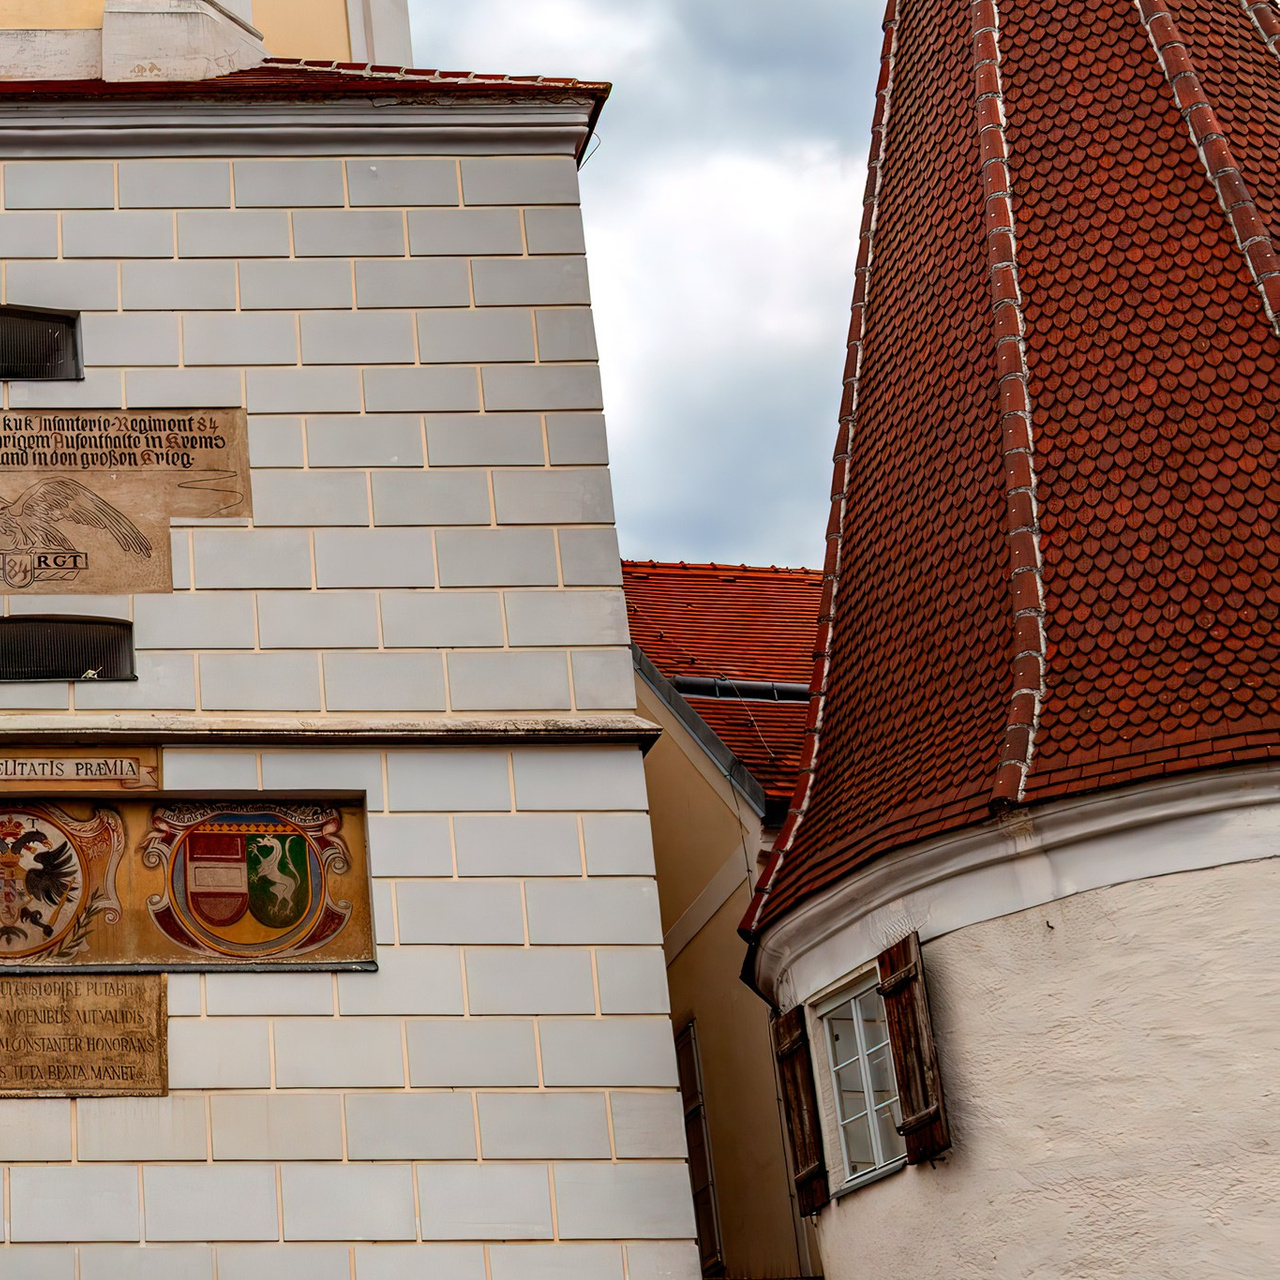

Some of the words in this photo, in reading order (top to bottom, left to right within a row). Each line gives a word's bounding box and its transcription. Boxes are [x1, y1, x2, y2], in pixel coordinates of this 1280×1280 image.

[196, 417, 219, 434] 84
[50, 432, 141, 451] Aufenthalte
[146, 433, 163, 449] in
[165, 433, 226, 449] Krems
[32, 450, 48, 466] in
[49, 450, 78, 466] den
[80, 450, 138, 469] großen
[6, 557, 32, 582] 84
[37, 554, 82, 568] RGT
[25, 818, 40, 829] T
[6, 1009, 71, 1025] MOENIBUS
[11, 1036, 83, 1052] CONSTANTER
[90, 1065, 136, 1080] MANET
